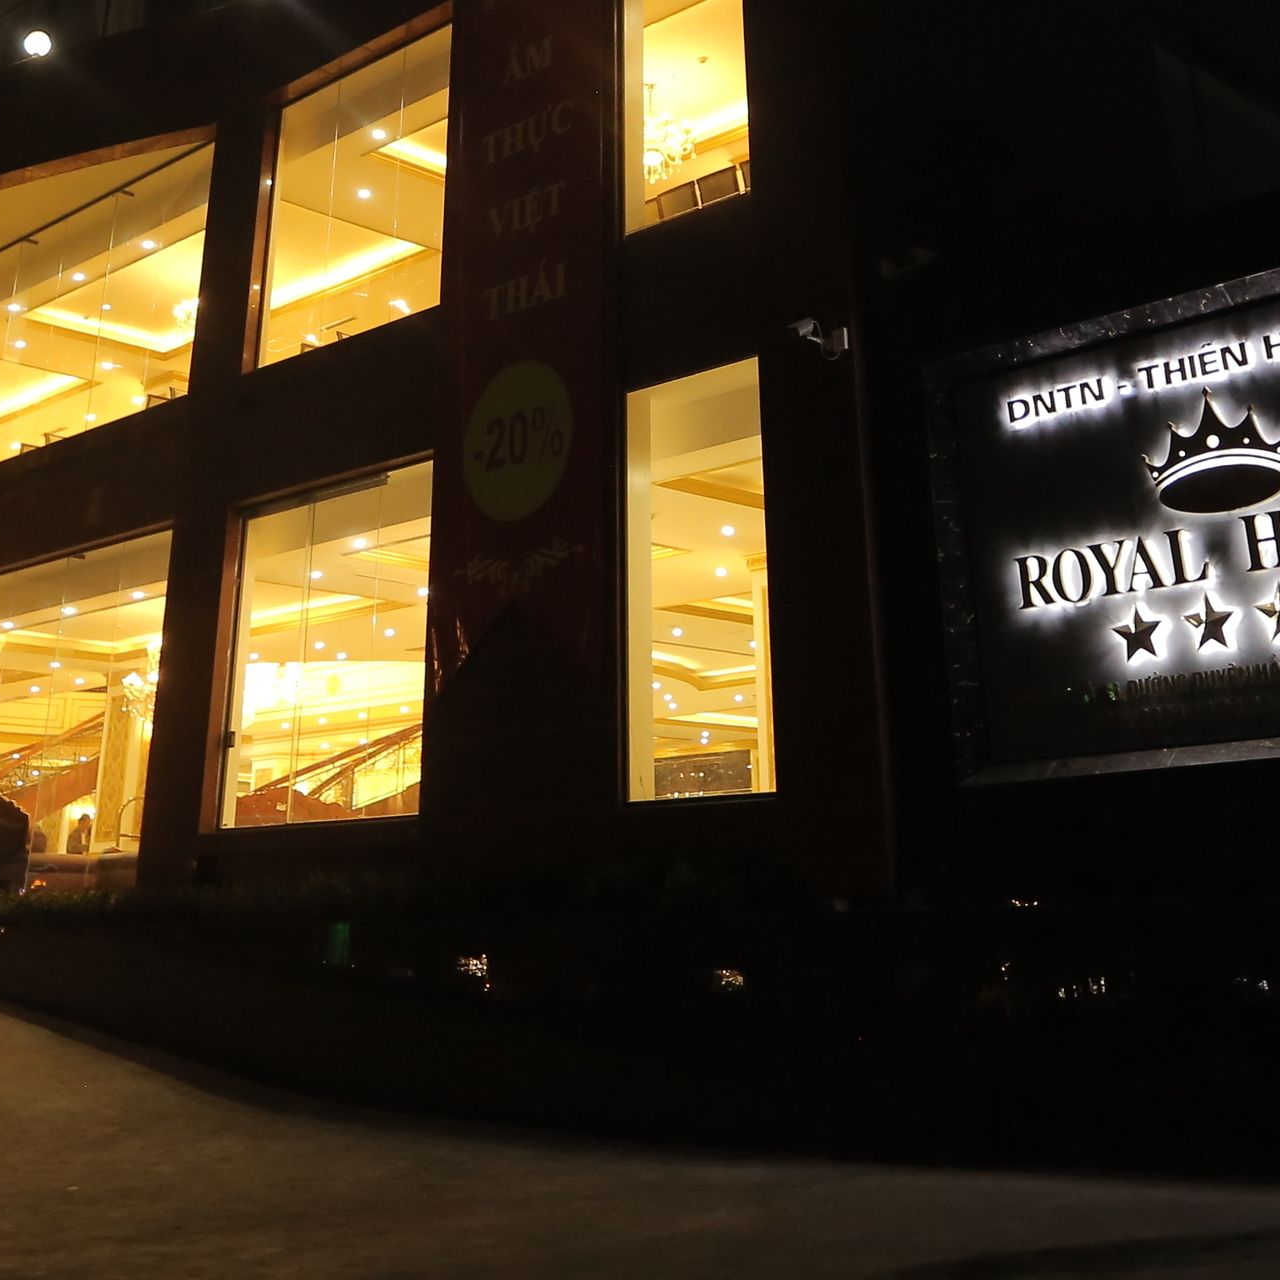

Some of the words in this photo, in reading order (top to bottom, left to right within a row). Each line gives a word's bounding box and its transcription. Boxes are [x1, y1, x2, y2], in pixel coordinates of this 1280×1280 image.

[486, 181, 568, 240] VIỆT
[483, 260, 570, 322] THÁI
[1007, 377, 1105, 423] DNTN
[472, 401, 565, 474] -20%
[1014, 528, 1210, 612] ROYAL
